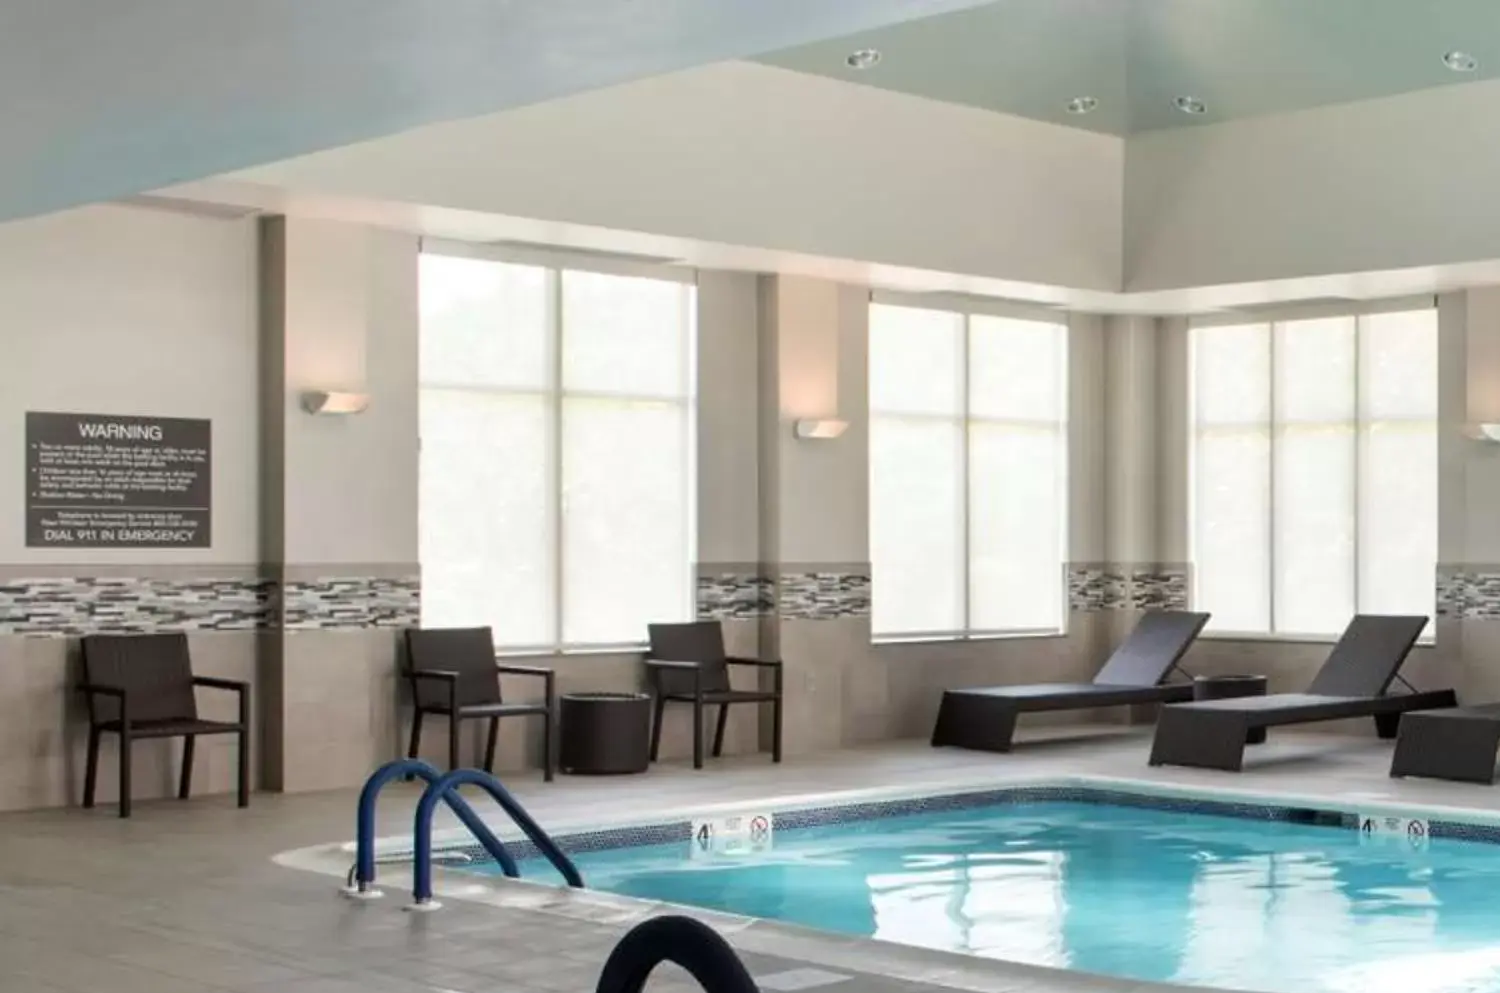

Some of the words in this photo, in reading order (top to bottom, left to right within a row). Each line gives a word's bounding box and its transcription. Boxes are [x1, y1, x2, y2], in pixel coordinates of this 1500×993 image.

[78, 422, 163, 441] WARNING
[44, 529, 74, 541] DIAL
[78, 529, 97, 541] 911
[101, 530, 115, 541] IN
[118, 530, 195, 542] EMERGENCY
